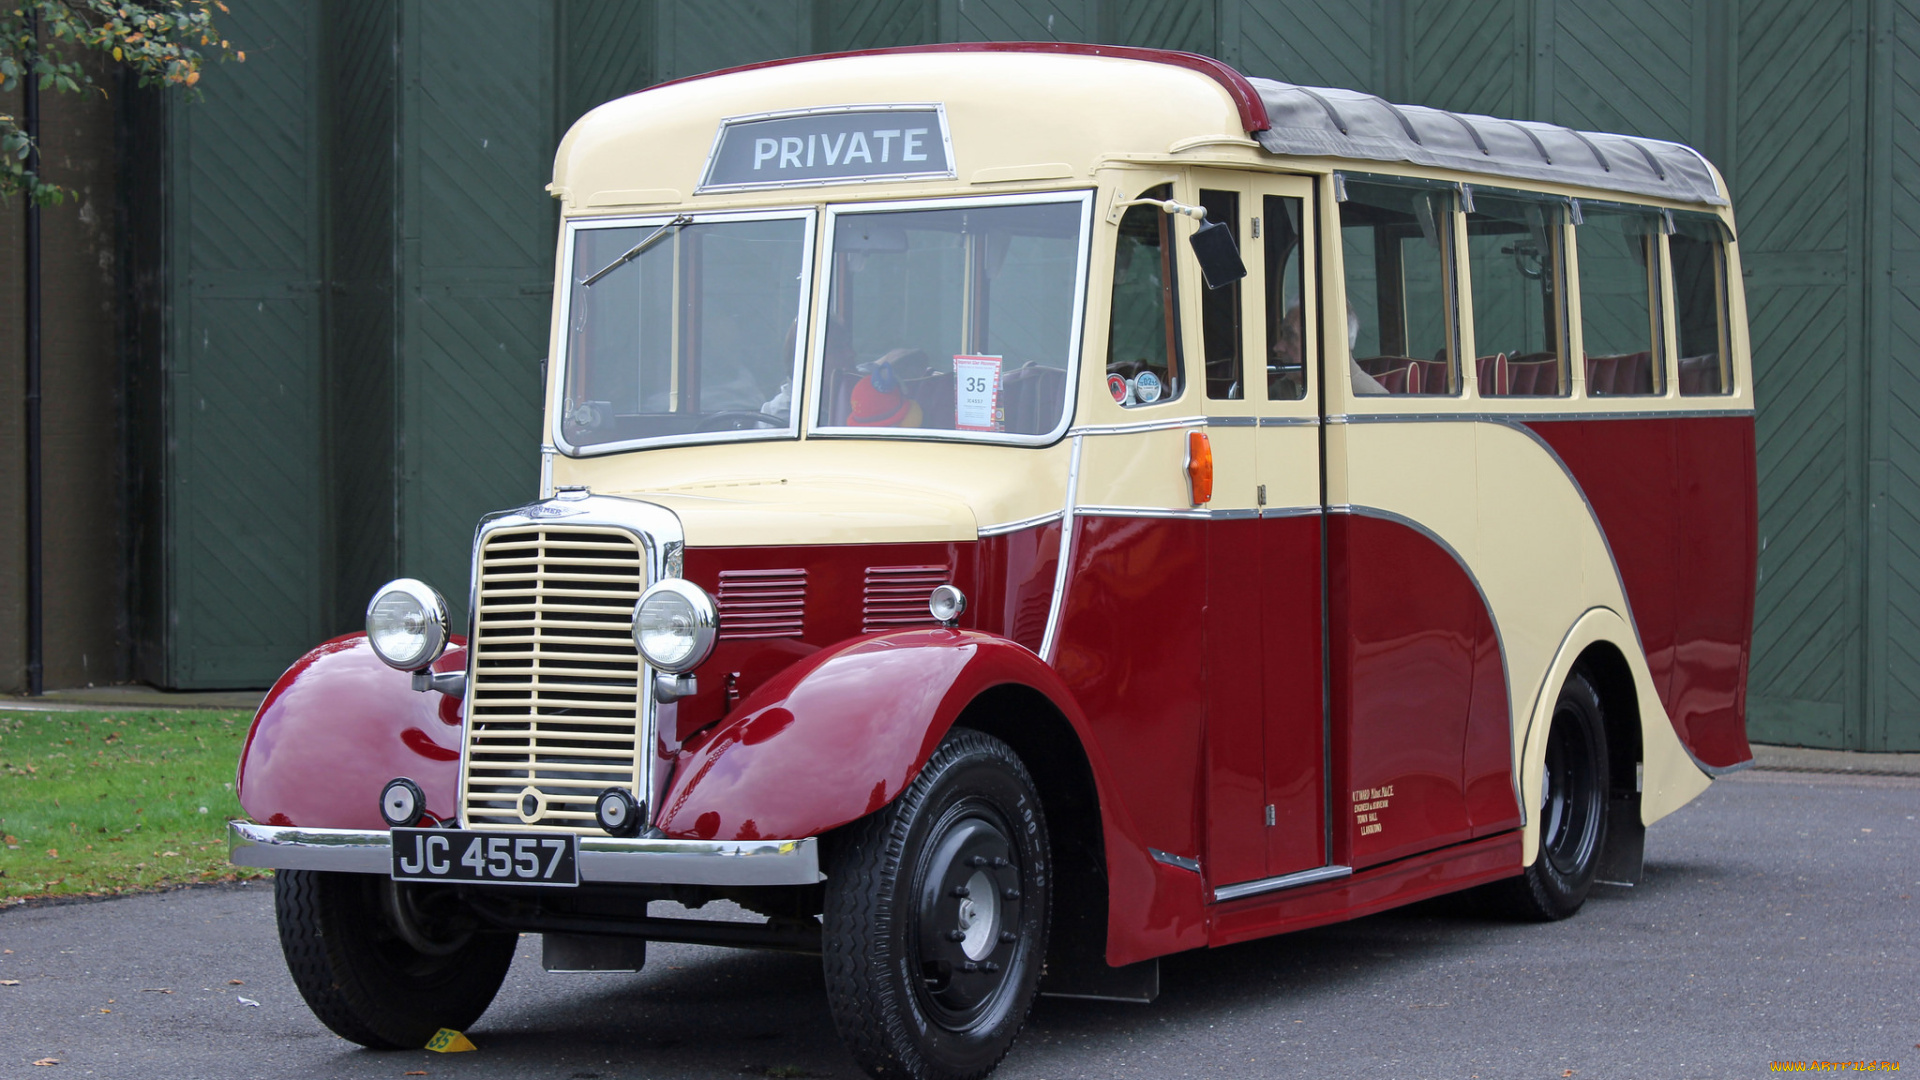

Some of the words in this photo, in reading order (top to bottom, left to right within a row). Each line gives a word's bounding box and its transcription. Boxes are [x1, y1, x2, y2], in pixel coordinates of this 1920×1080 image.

[753, 128, 928, 170] PRIVATE
[966, 377, 986, 393] 35
[400, 835, 450, 875] JC
[461, 837, 566, 879] 4557
[428, 1030, 456, 1049] 35
